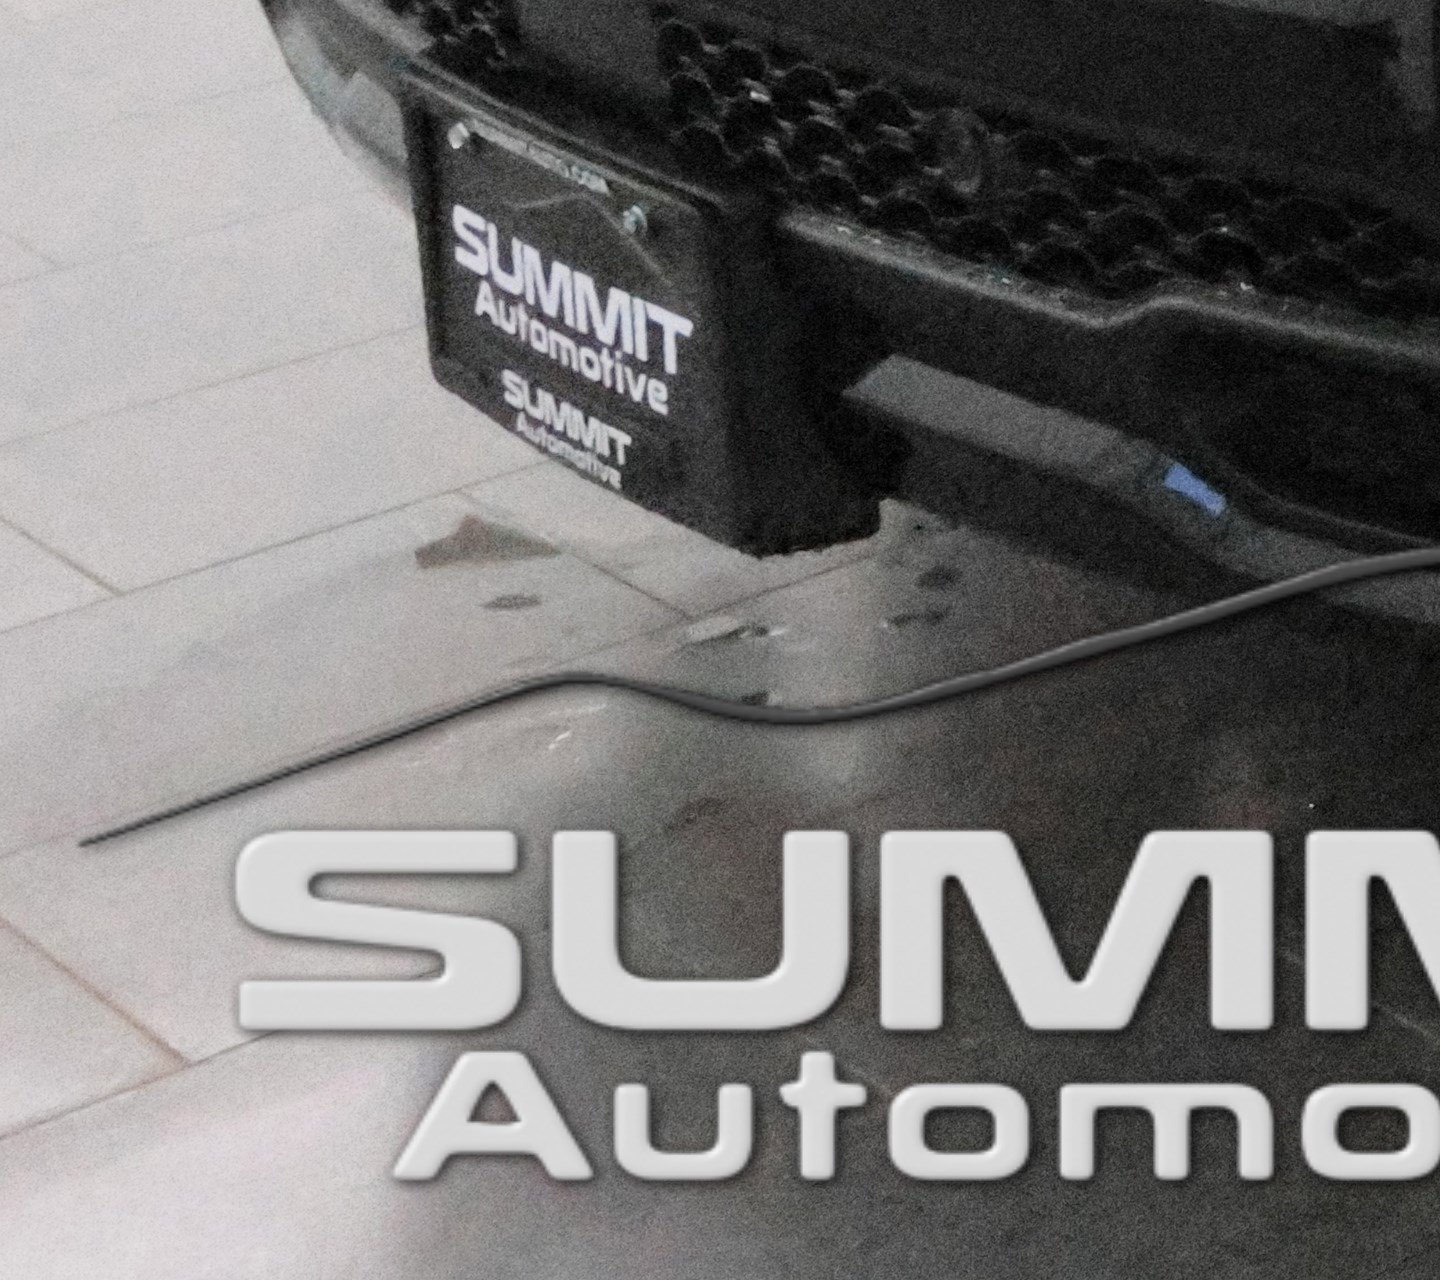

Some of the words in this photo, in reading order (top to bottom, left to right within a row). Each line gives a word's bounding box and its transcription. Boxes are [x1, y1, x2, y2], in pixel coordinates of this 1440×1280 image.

[450, 204, 694, 376] SUMMIT
[474, 280, 670, 416] Automotive
[501, 368, 632, 466] SUMMIT
